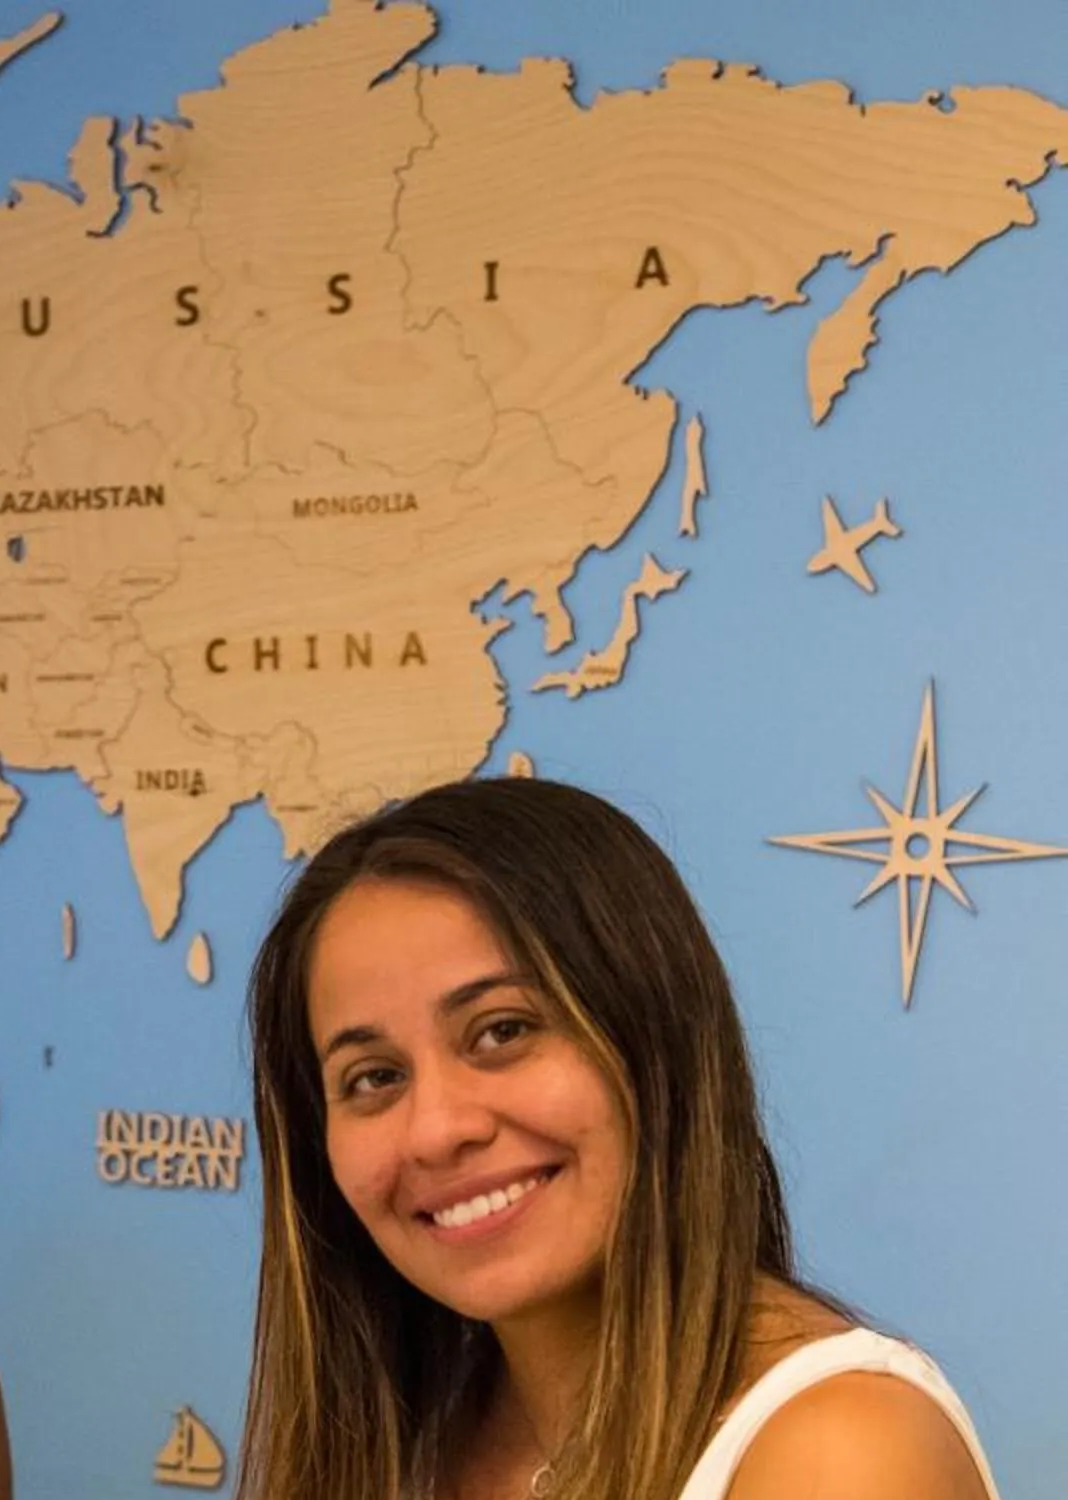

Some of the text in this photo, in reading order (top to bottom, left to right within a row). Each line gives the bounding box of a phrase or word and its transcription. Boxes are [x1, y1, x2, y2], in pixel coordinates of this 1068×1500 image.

[293, 492, 419, 518] MONGOLIA
[204, 630, 429, 674] CHINA
[136, 768, 207, 792] INDIA
[97, 1110, 244, 1157] INDIAN
[98, 1150, 240, 1192] OCEAN
